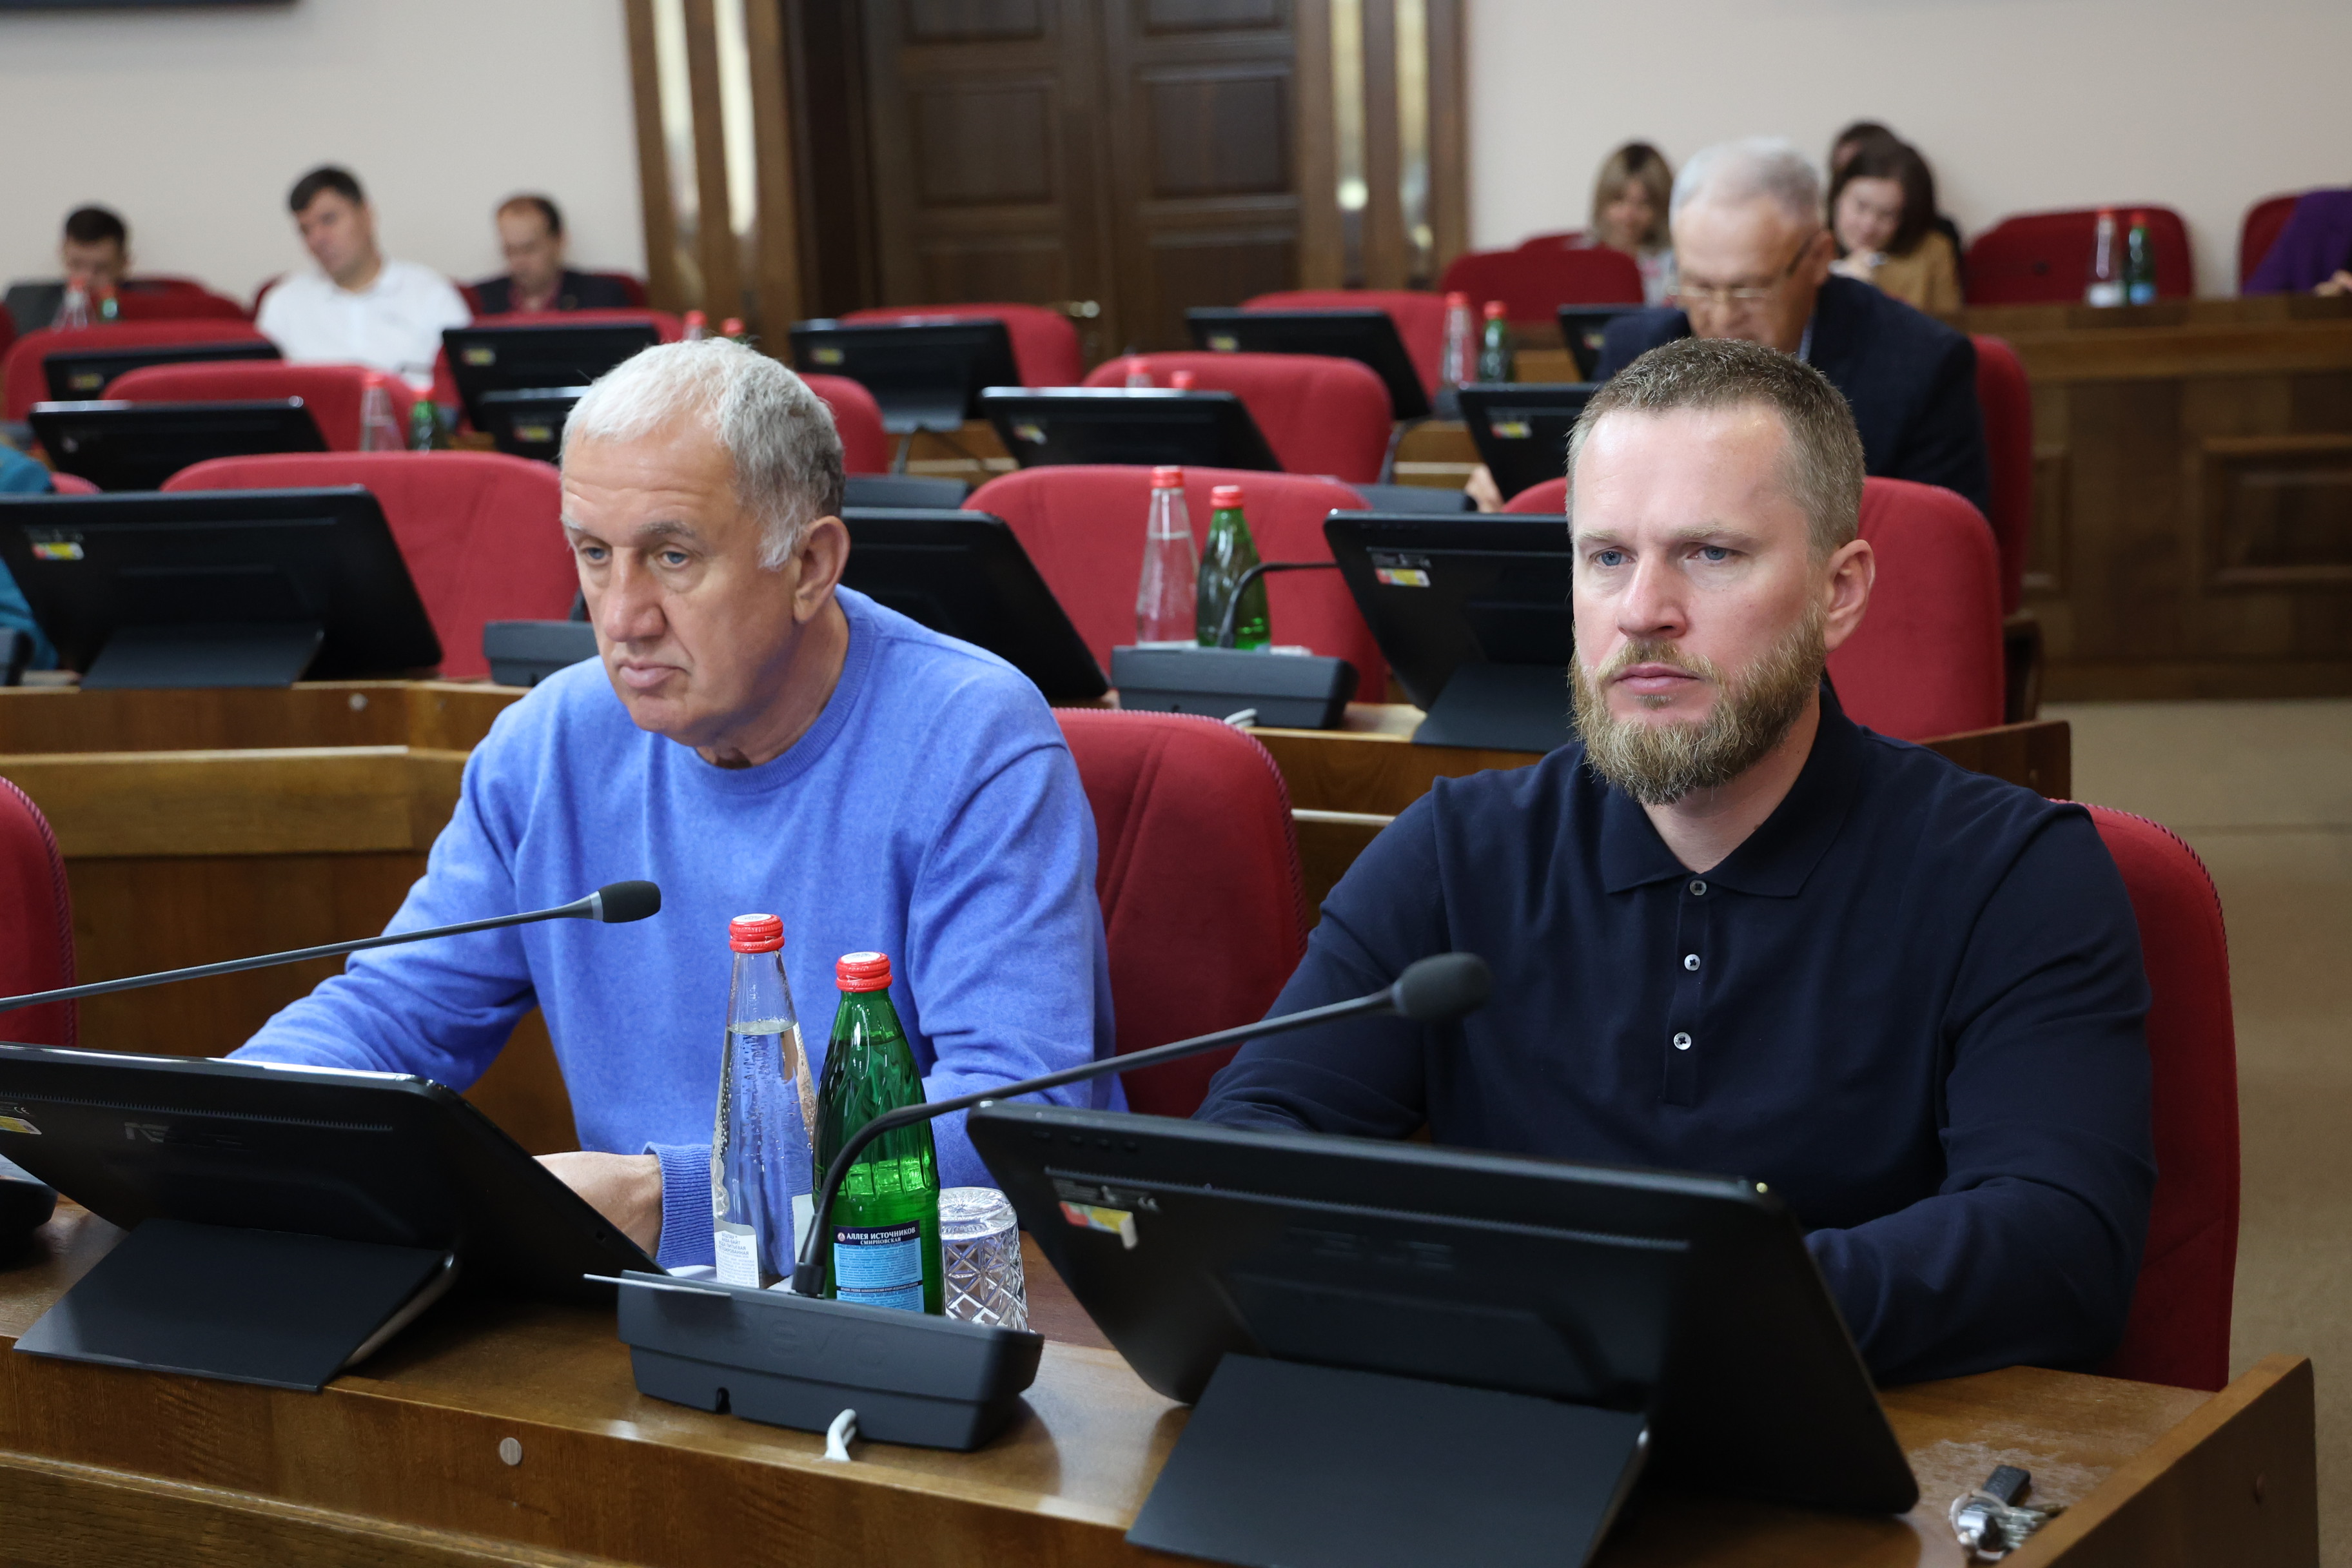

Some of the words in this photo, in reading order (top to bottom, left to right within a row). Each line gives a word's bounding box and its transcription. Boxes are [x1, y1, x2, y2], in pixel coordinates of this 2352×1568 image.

[847, 1232, 868, 1240] АЛЛЕЯ
[870, 1226, 916, 1239] ИСТОЧНИКОВ
[860, 1237, 901, 1245] СМИРНОВСКАЯ
